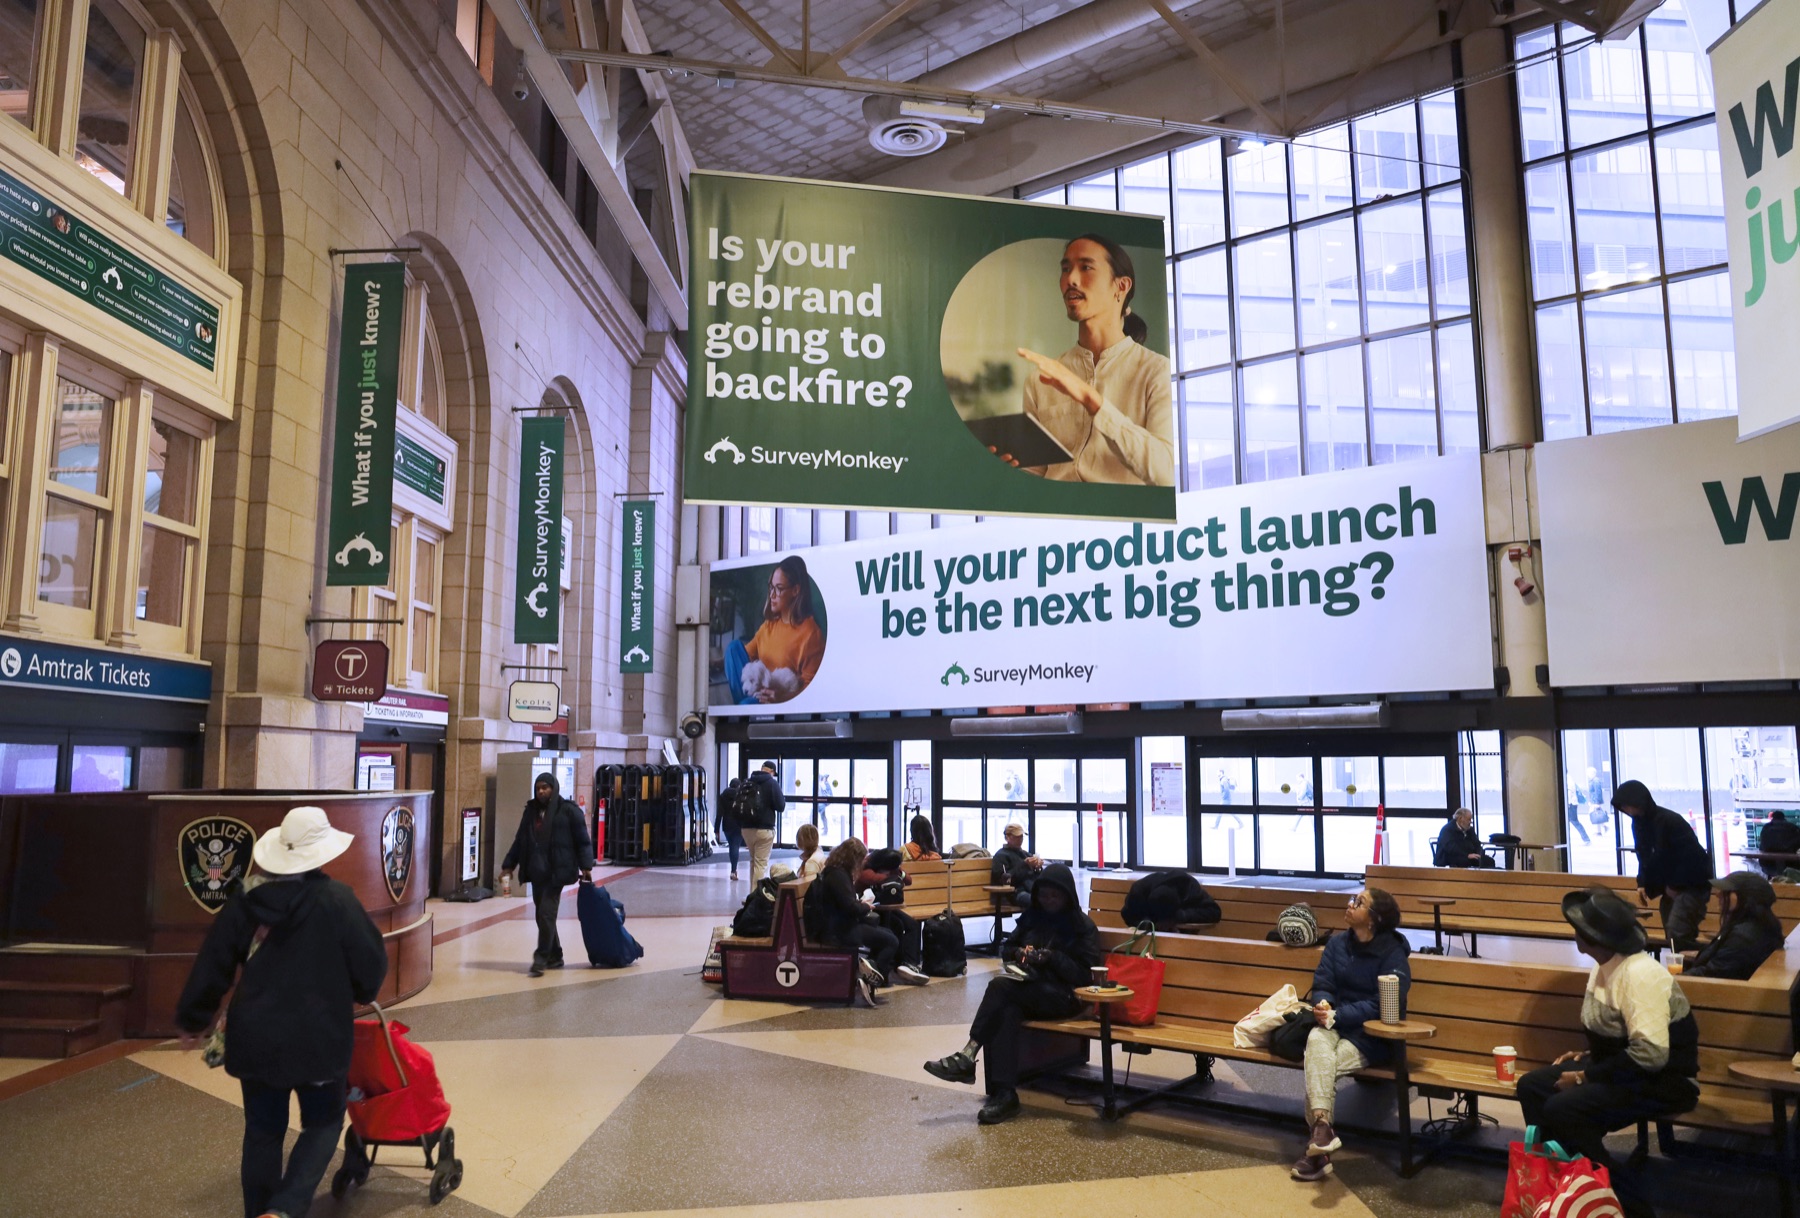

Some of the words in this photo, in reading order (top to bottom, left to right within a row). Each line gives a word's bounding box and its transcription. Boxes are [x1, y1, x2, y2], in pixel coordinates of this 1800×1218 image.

[1728, 56, 1800, 179] W
[9, 187, 21, 200] hate
[21, 196, 31, 206] you
[10, 216, 27, 231] pricing
[28, 225, 41, 238] leave
[41, 234, 60, 249] revenue
[74, 254, 86, 265] table
[79, 231, 87, 241] Will
[87, 238, 99, 248] pizza
[708, 228, 744, 261] Is
[756, 238, 856, 273] your
[13, 242, 29, 256] Where
[29, 253, 46, 266] should
[46, 263, 55, 271] you
[55, 267, 69, 280] invest
[69, 276, 80, 285] next
[104, 296, 114, 304] your
[360, 281, 381, 345] knew?
[707, 274, 882, 318] rebrand
[705, 316, 829, 364] going
[840, 327, 886, 359] to
[357, 349, 379, 389] just
[706, 362, 912, 408] backfire?
[360, 392, 378, 429] you
[354, 432, 372, 447] if
[751, 446, 904, 473] SurveyMonkey
[352, 450, 371, 507] What
[532, 445, 556, 578] SurveyMonkey
[1702, 472, 1800, 545] W
[632, 510, 643, 545] knew?
[855, 550, 925, 596] Will
[934, 547, 1027, 599] your
[1038, 516, 1228, 588] product
[1241, 485, 1437, 555] launch
[632, 547, 644, 569] just
[632, 591, 641, 600] if
[634, 570, 644, 590] you
[882, 599, 927, 639] be
[935, 591, 1002, 634] the
[1014, 582, 1112, 628] next
[1125, 570, 1201, 628] big
[1211, 551, 1394, 617] thing?
[631, 602, 641, 632] What
[27, 654, 94, 682] Amtrak
[100, 662, 151, 688] Tickets
[974, 662, 1094, 685] SurveyMonkey
[337, 685, 374, 695] Tickets
[375, 707, 395, 716] TICKETING
[187, 822, 248, 844] POLICE
